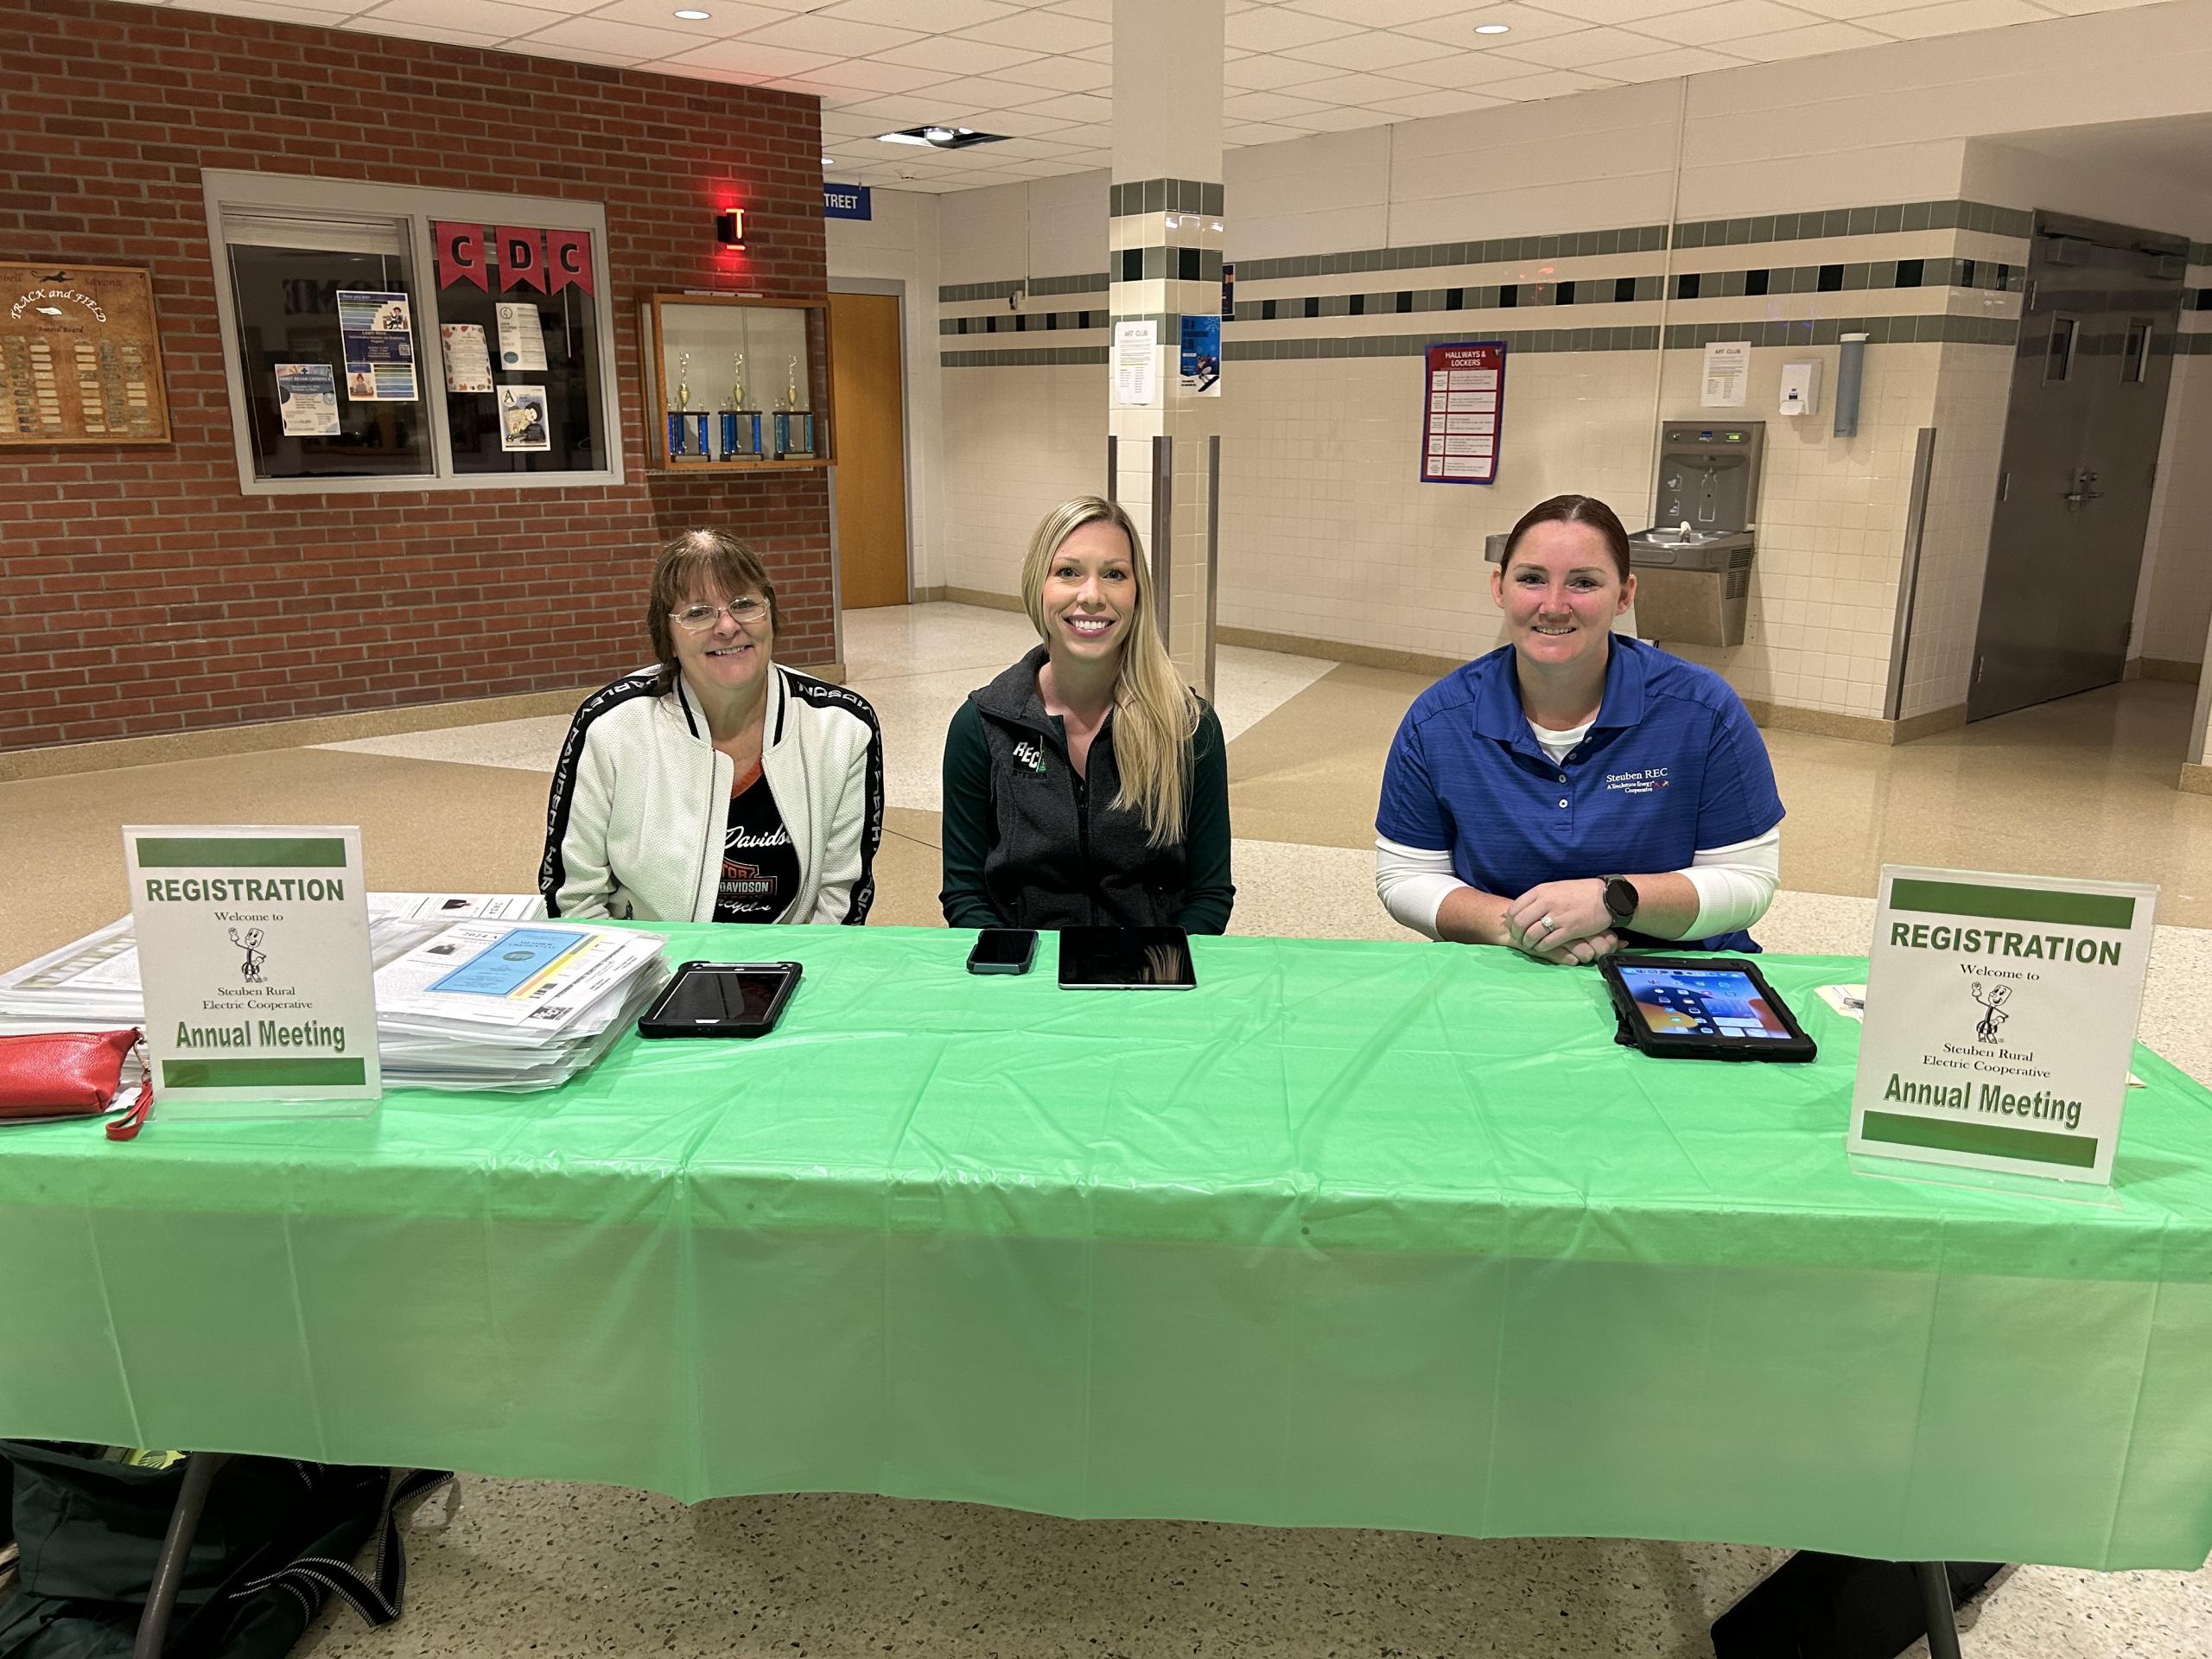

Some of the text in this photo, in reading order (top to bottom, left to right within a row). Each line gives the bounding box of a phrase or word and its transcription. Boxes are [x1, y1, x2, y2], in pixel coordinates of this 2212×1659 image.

[823, 194, 858, 209] TREET
[10, 289, 107, 323] TRACK and FIELD
[1012, 741, 1040, 769] REC
[1606, 767, 1669, 783] Steuben REC
[145, 879, 344, 901] REGISTRATION
[214, 912, 283, 922] Welcome to
[1891, 922, 2121, 966] REGISTRATION
[1961, 963, 2040, 982] Welcome to
[217, 987, 296, 996] Steuben Rural
[203, 1000, 313, 1011] Electric Cooperative
[175, 1020, 346, 1054] Annual Meeting
[1943, 1043, 2033, 1063] Steuben Rural
[1923, 1054, 2051, 1079] Electric Cooperative
[1883, 1073, 2082, 1130] Annual Meeting
